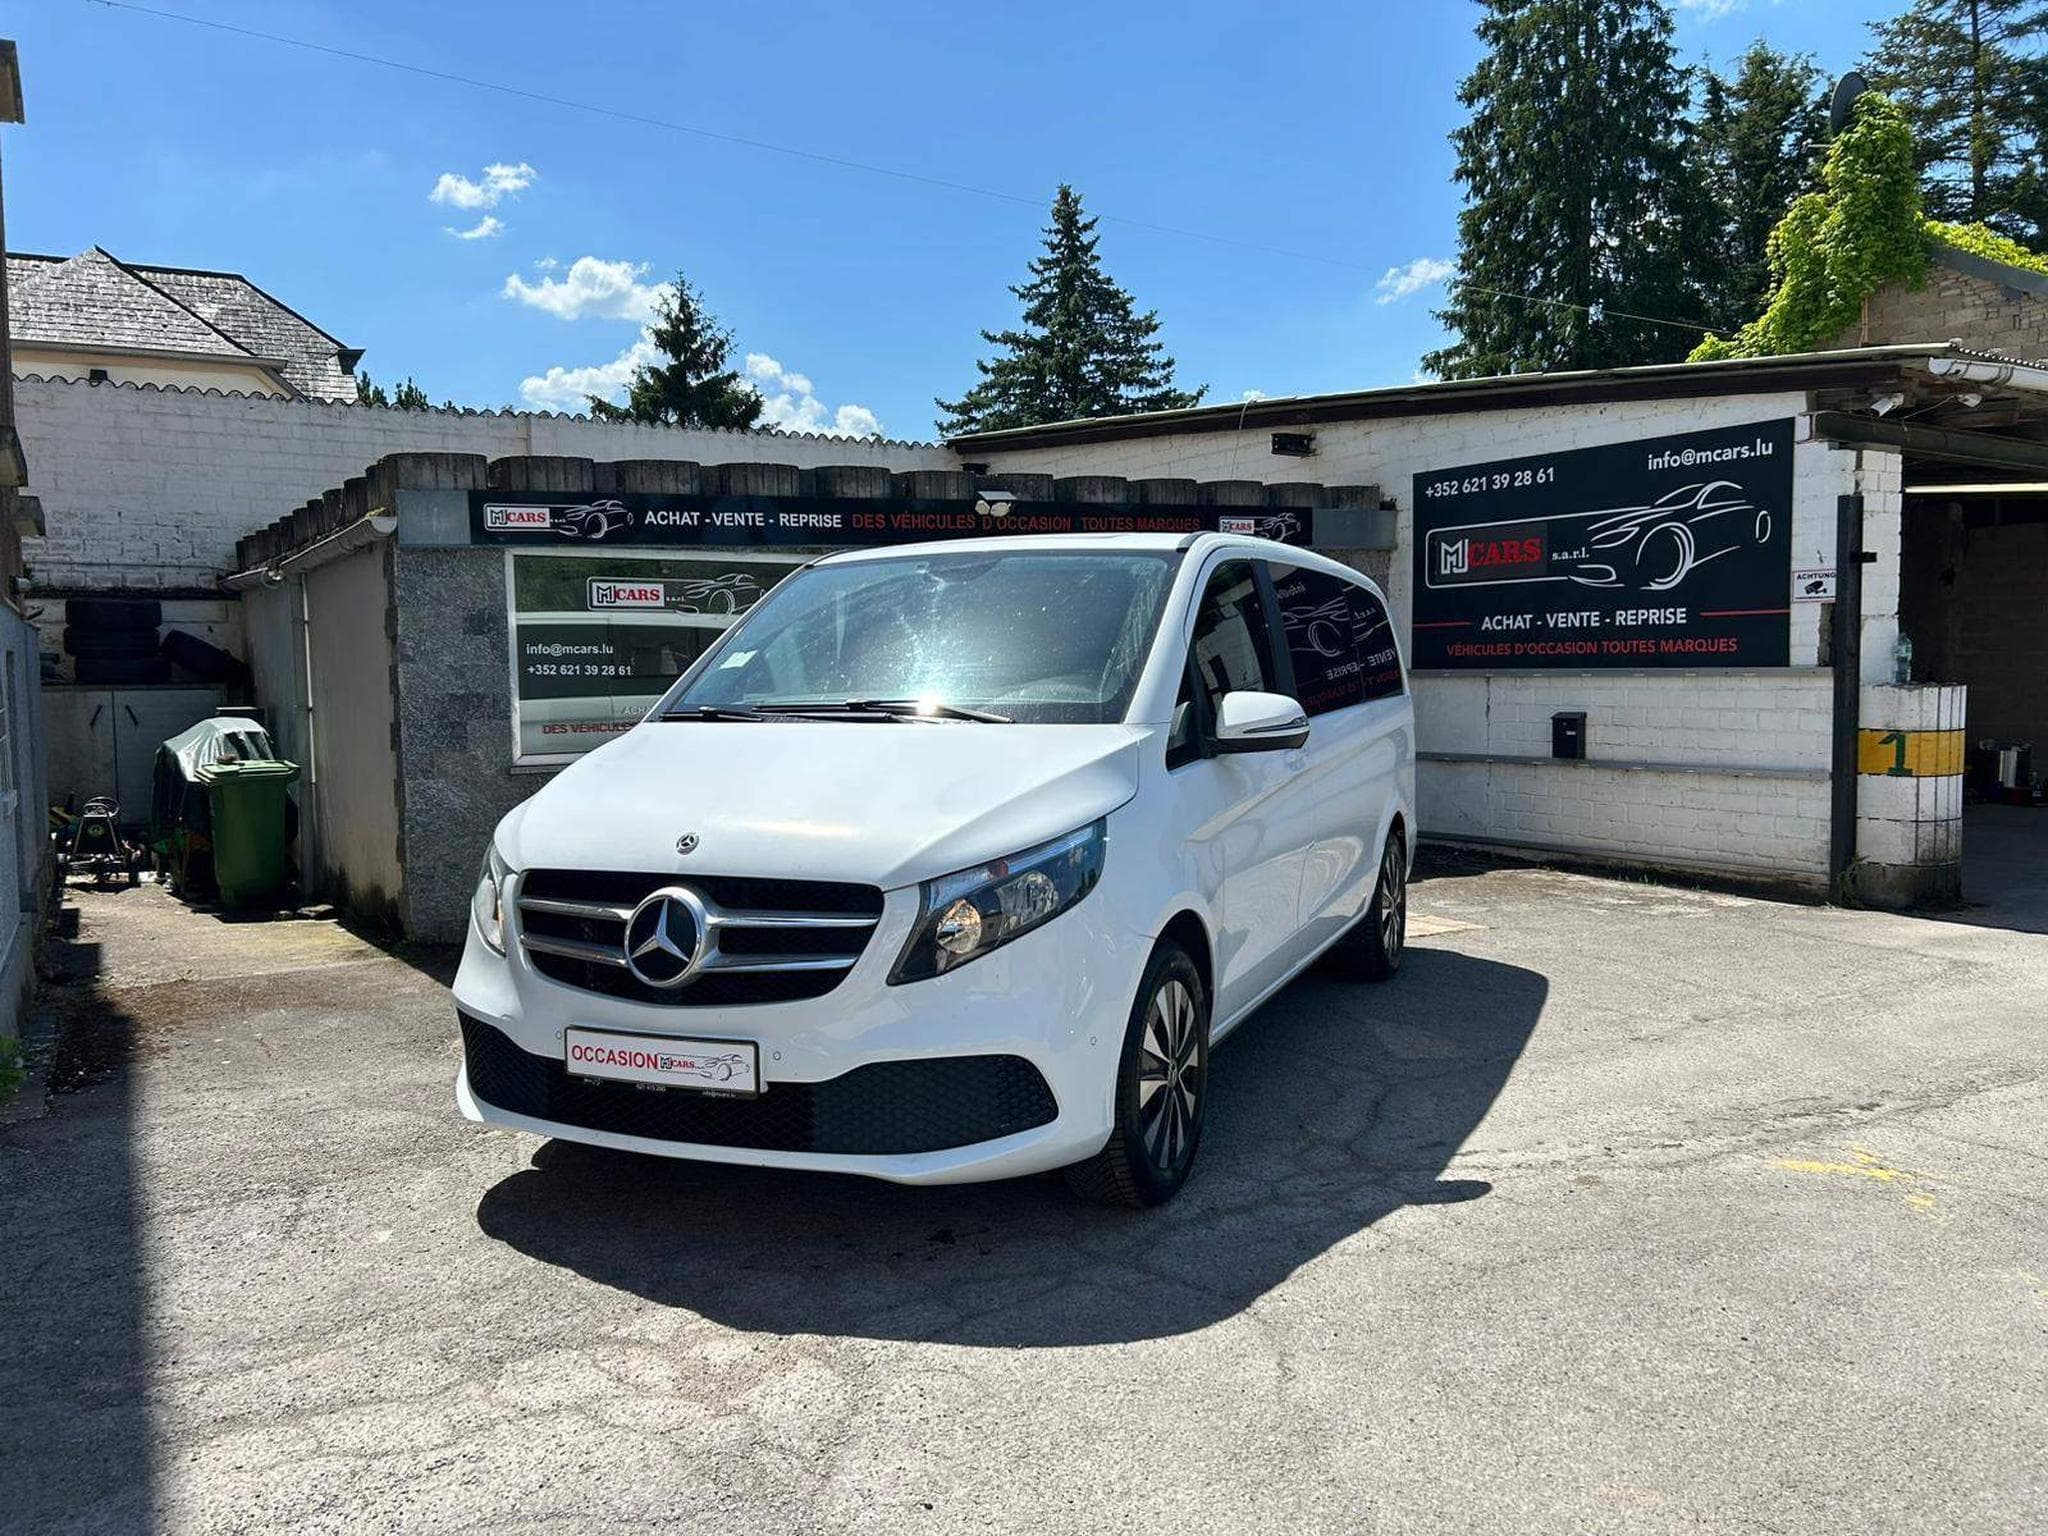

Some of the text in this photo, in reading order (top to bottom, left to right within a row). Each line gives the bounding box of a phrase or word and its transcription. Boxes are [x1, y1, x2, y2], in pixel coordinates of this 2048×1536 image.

[1647, 438, 1773, 470] info@mcars.lu
[1425, 467, 1554, 498] +352 621 39 28 61
[644, 511, 700, 526] ACHAT
[779, 513, 843, 528] REPRISE
[852, 514, 887, 529] DES
[890, 511, 976, 529] VÉHICULES
[982, 515, 1071, 530] DOCCASION
[1081, 517, 1134, 531] TOUTES
[1136, 517, 1201, 531] MARQUES
[1796, 571, 1837, 580] ACHTUNG
[1481, 614, 1534, 630] ACHAT
[1546, 611, 1601, 628] VENTE
[1615, 608, 1687, 625] REPRISE
[526, 643, 614, 657] info@mcars.lu
[1446, 637, 1738, 657] VÉHICULES D'OCCASION TOUTES MARQUES
[527, 664, 557, 675] +352
[559, 664, 580, 675] 621
[584, 664, 598, 675] 39
[601, 664, 615, 676] 28
[543, 723, 568, 734] DES
[1877, 731, 1913, 776] 1
[571, 1045, 659, 1070] OCCASION
